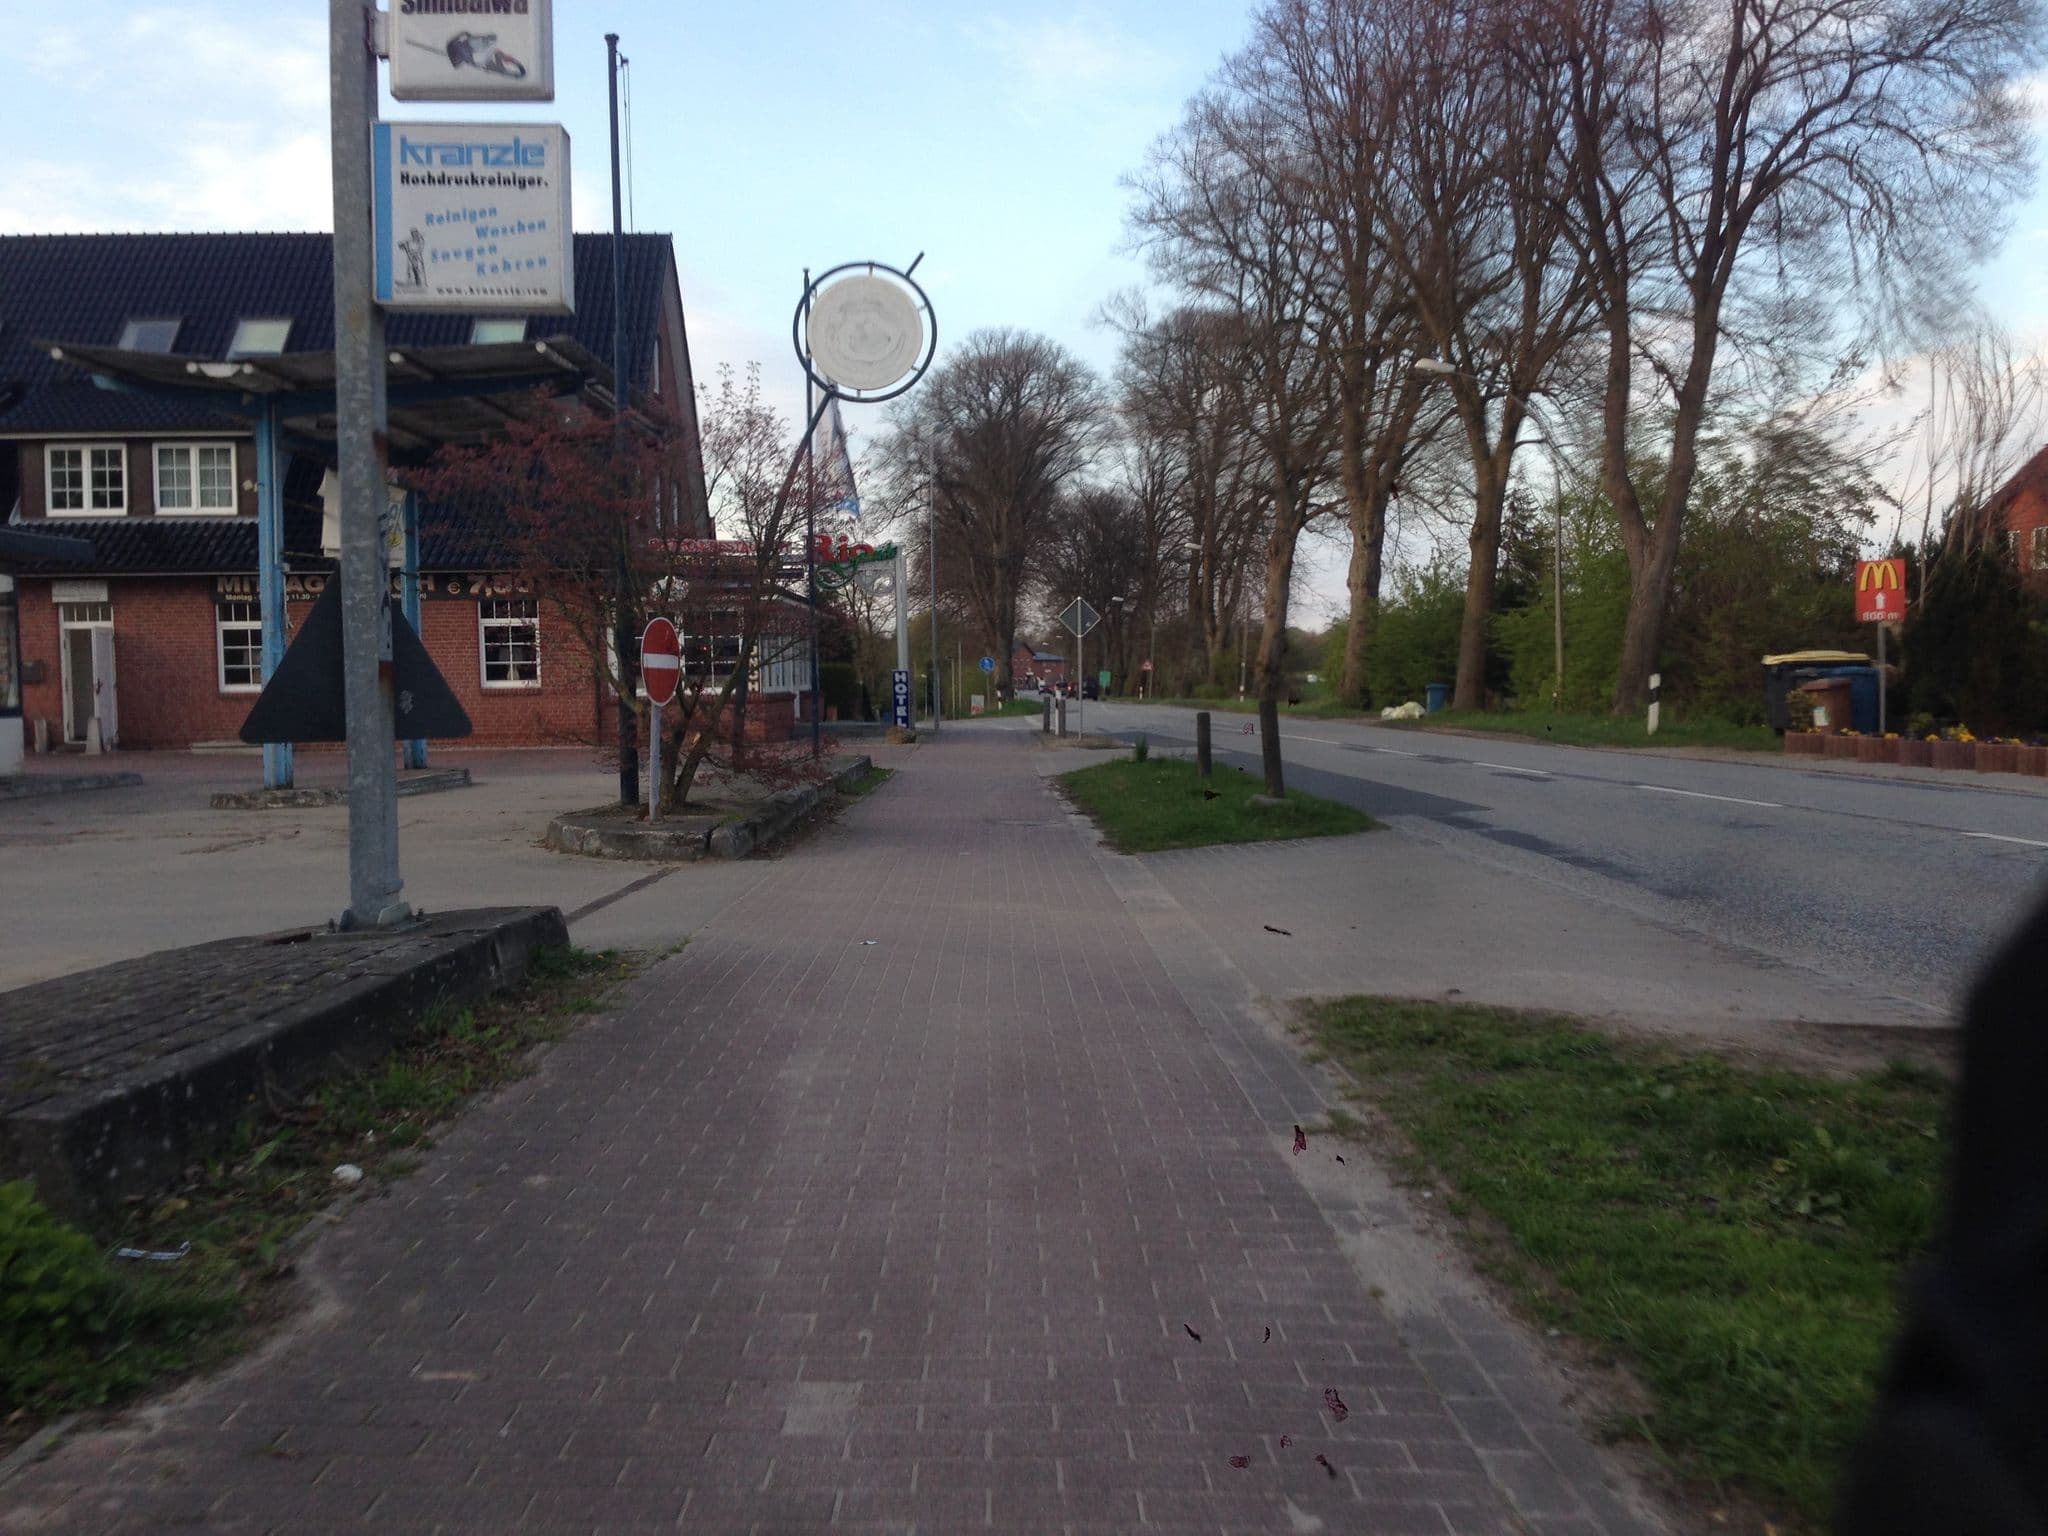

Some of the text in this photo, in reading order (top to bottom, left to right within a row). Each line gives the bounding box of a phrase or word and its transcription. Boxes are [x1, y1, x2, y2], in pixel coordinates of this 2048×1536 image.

[424, 206, 498, 226] Reinigen
[475, 219, 547, 239] Waschen
[430, 243, 498, 264] Saugen
[475, 255, 548, 276] Kehren
[894, 671, 908, 728] HOTEL
